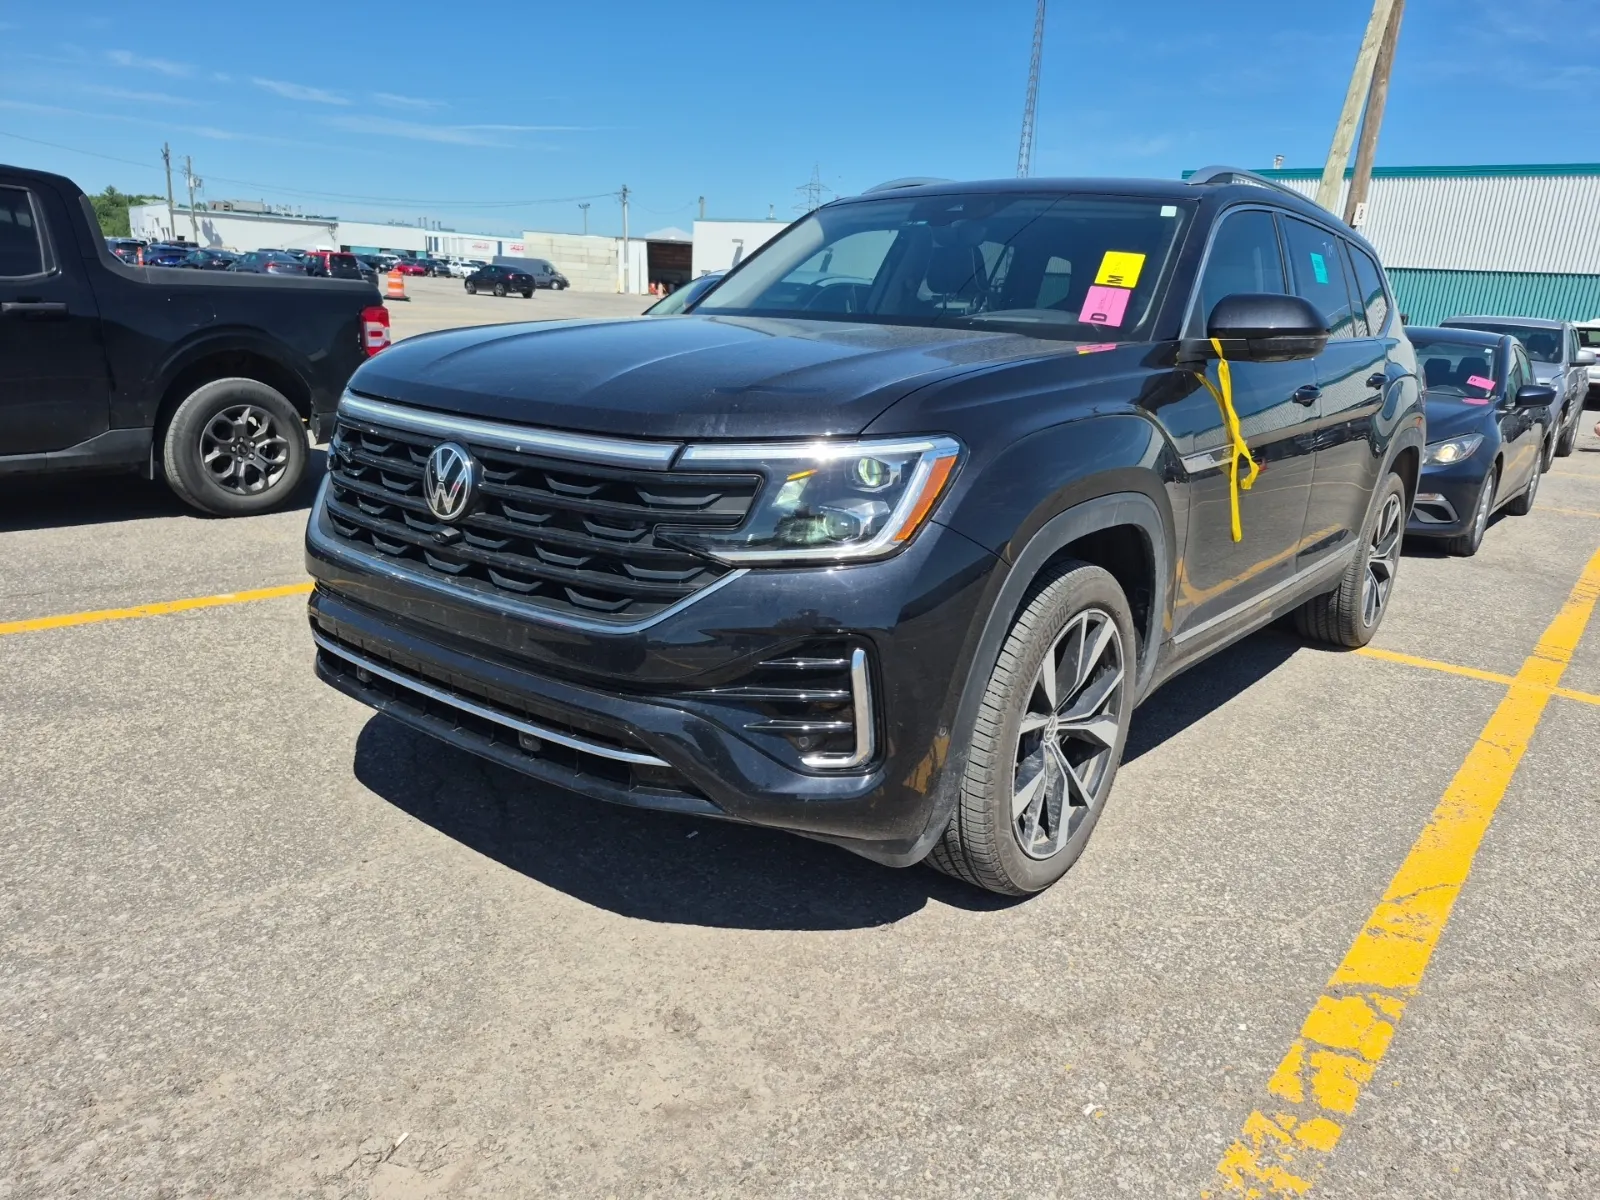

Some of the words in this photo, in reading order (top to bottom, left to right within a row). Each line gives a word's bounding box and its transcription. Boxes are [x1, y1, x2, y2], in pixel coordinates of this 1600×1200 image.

[1106, 274, 1124, 285] M
[1090, 312, 1108, 323] D
[426, 446, 468, 515] VW
